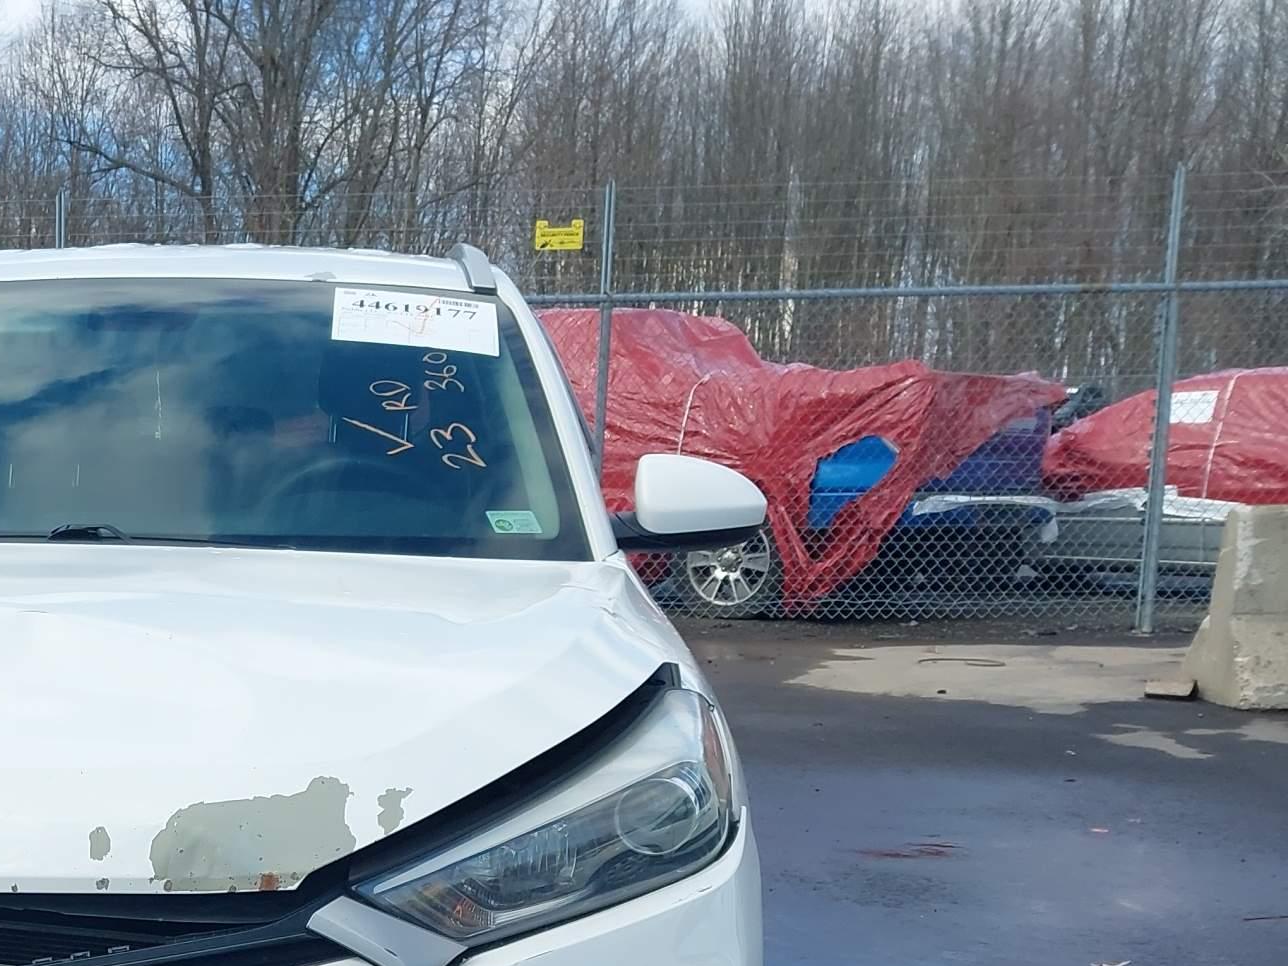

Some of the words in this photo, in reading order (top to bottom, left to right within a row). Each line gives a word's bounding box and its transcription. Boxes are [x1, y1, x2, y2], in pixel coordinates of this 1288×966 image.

[351, 299, 478, 320] 44619177
[422, 351, 465, 393] 360
[430, 423, 488, 470] 23
